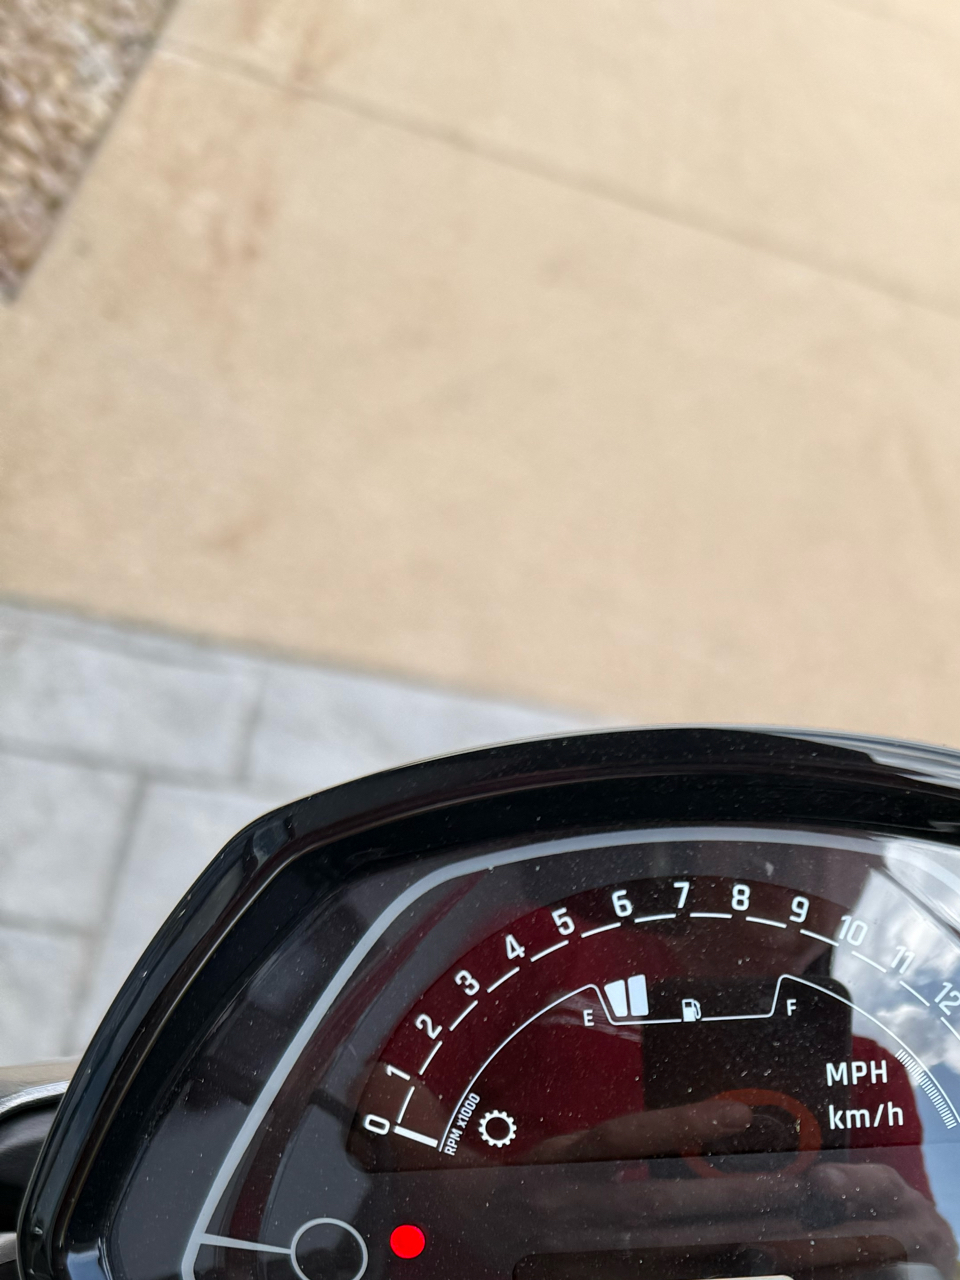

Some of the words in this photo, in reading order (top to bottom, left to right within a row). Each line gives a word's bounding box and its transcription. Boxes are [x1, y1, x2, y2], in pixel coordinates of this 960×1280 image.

[364, 1114, 390, 1135] 0
[386, 1063, 411, 1081] 1
[416, 1014, 442, 1040] 2
[454, 970, 480, 996] 3
[505, 934, 525, 960] 4
[552, 908, 575, 936] 5
[611, 889, 633, 917] 6
[673, 881, 690, 909] 7
[731, 884, 750, 911] 8
[789, 896, 810, 923] 9
[838, 915, 868, 947] 10
[890, 945, 916, 974] 11
[583, 1009, 595, 1027] E
[786, 999, 797, 1016] F
[826, 1060, 888, 1086] MPH
[828, 1102, 904, 1130] km/h
[444, 1128, 463, 1156] RPM
